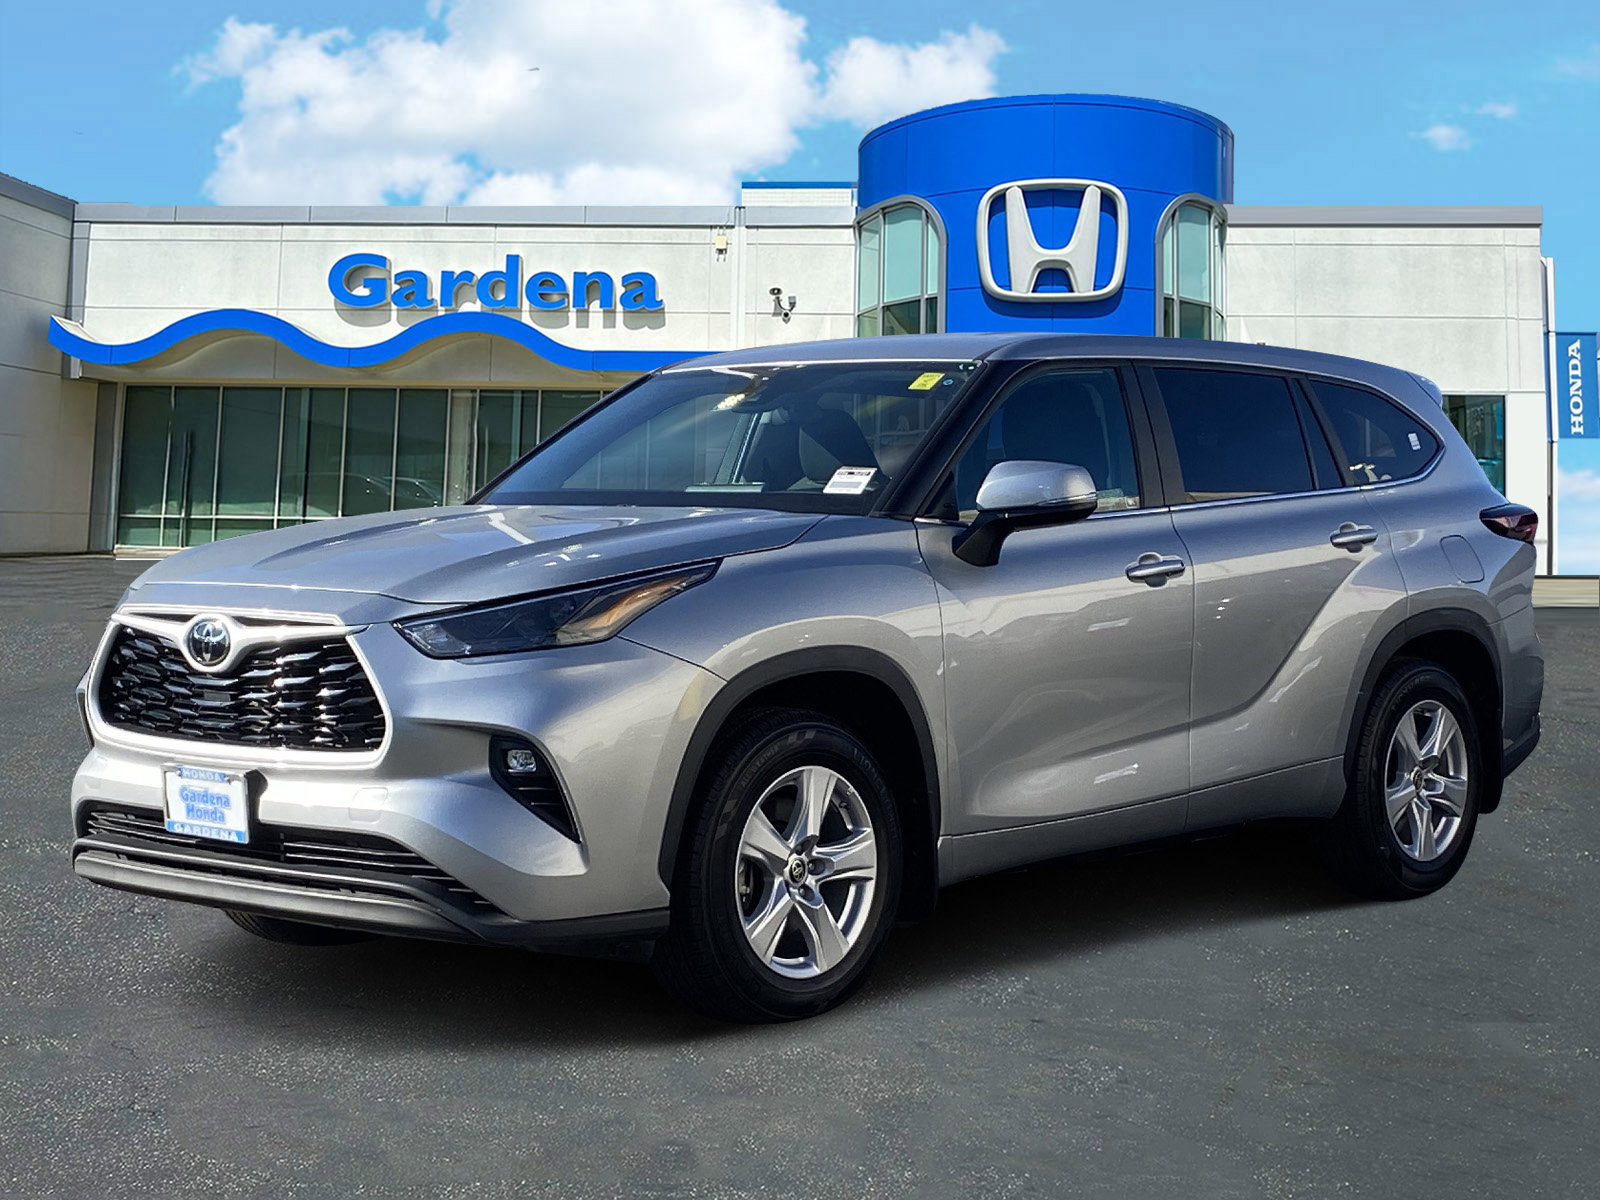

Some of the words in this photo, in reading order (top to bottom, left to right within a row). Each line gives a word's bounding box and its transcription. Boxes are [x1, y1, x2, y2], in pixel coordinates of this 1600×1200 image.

[328, 253, 664, 311] Gardena
[1568, 339, 1584, 435] HONDA
[182, 767, 222, 782] HONDA
[181, 786, 230, 807] Gardena
[186, 803, 225, 823] Honda
[174, 823, 238, 841] GARDENA
